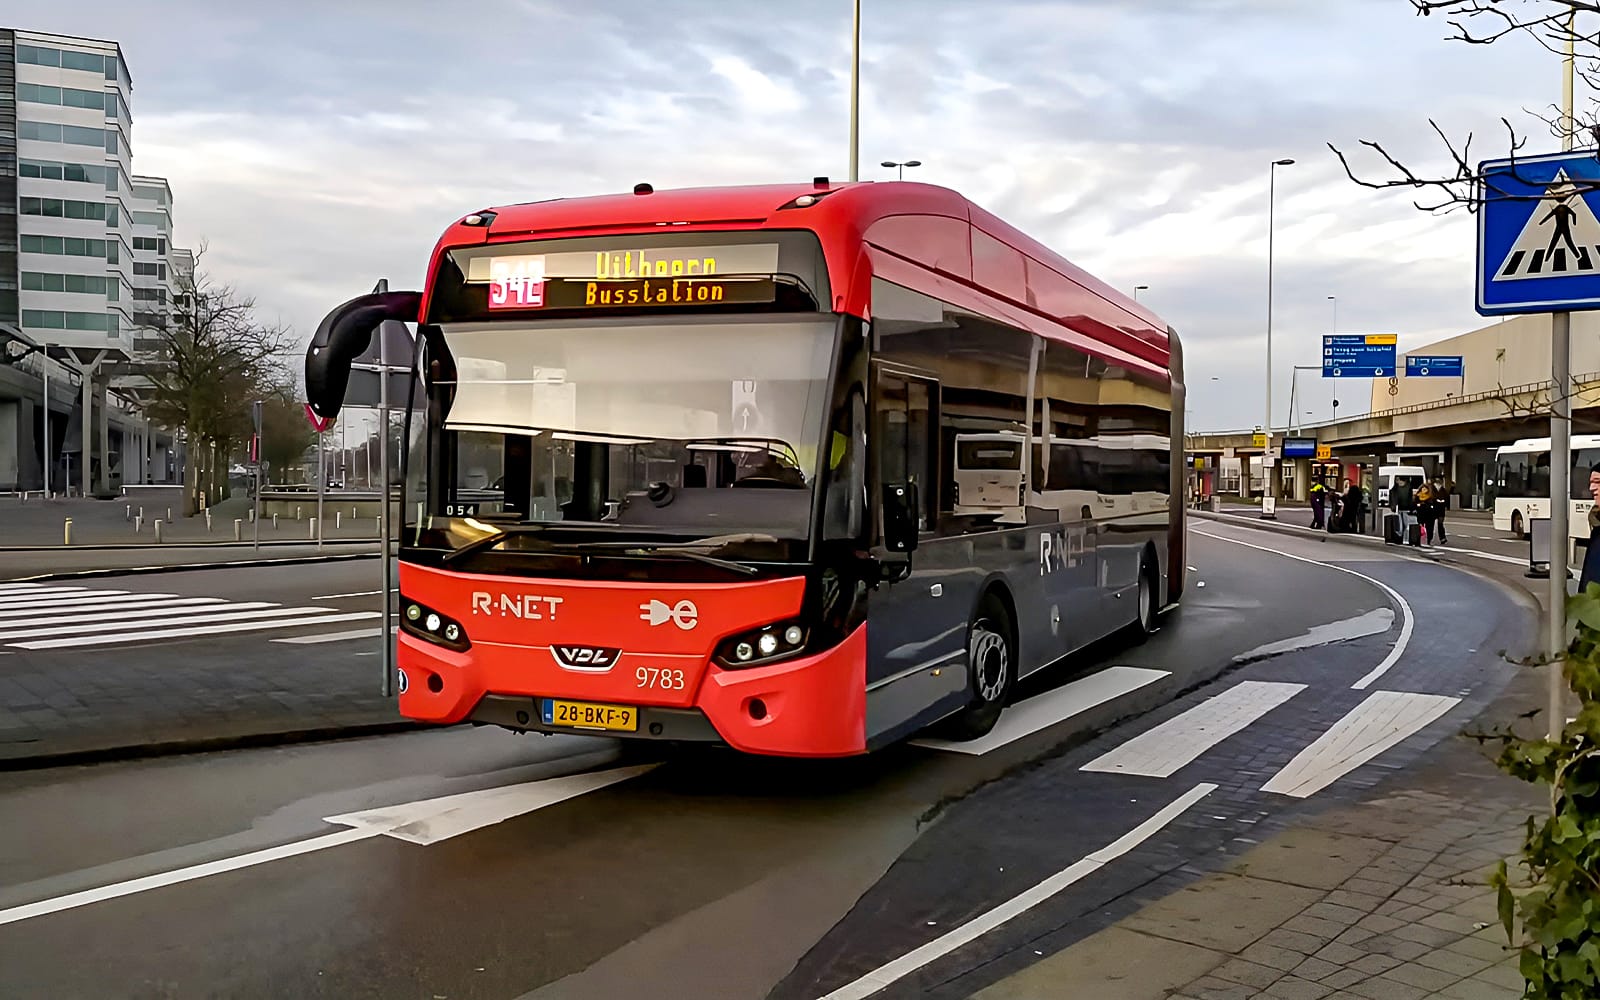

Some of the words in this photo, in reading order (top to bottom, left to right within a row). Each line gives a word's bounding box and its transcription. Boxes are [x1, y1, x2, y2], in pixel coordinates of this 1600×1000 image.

[586, 279, 723, 305] Busstation
[560, 647, 609, 663] VDL
[635, 666, 685, 690] 9783
[558, 704, 631, 726] 28-BKF-9
